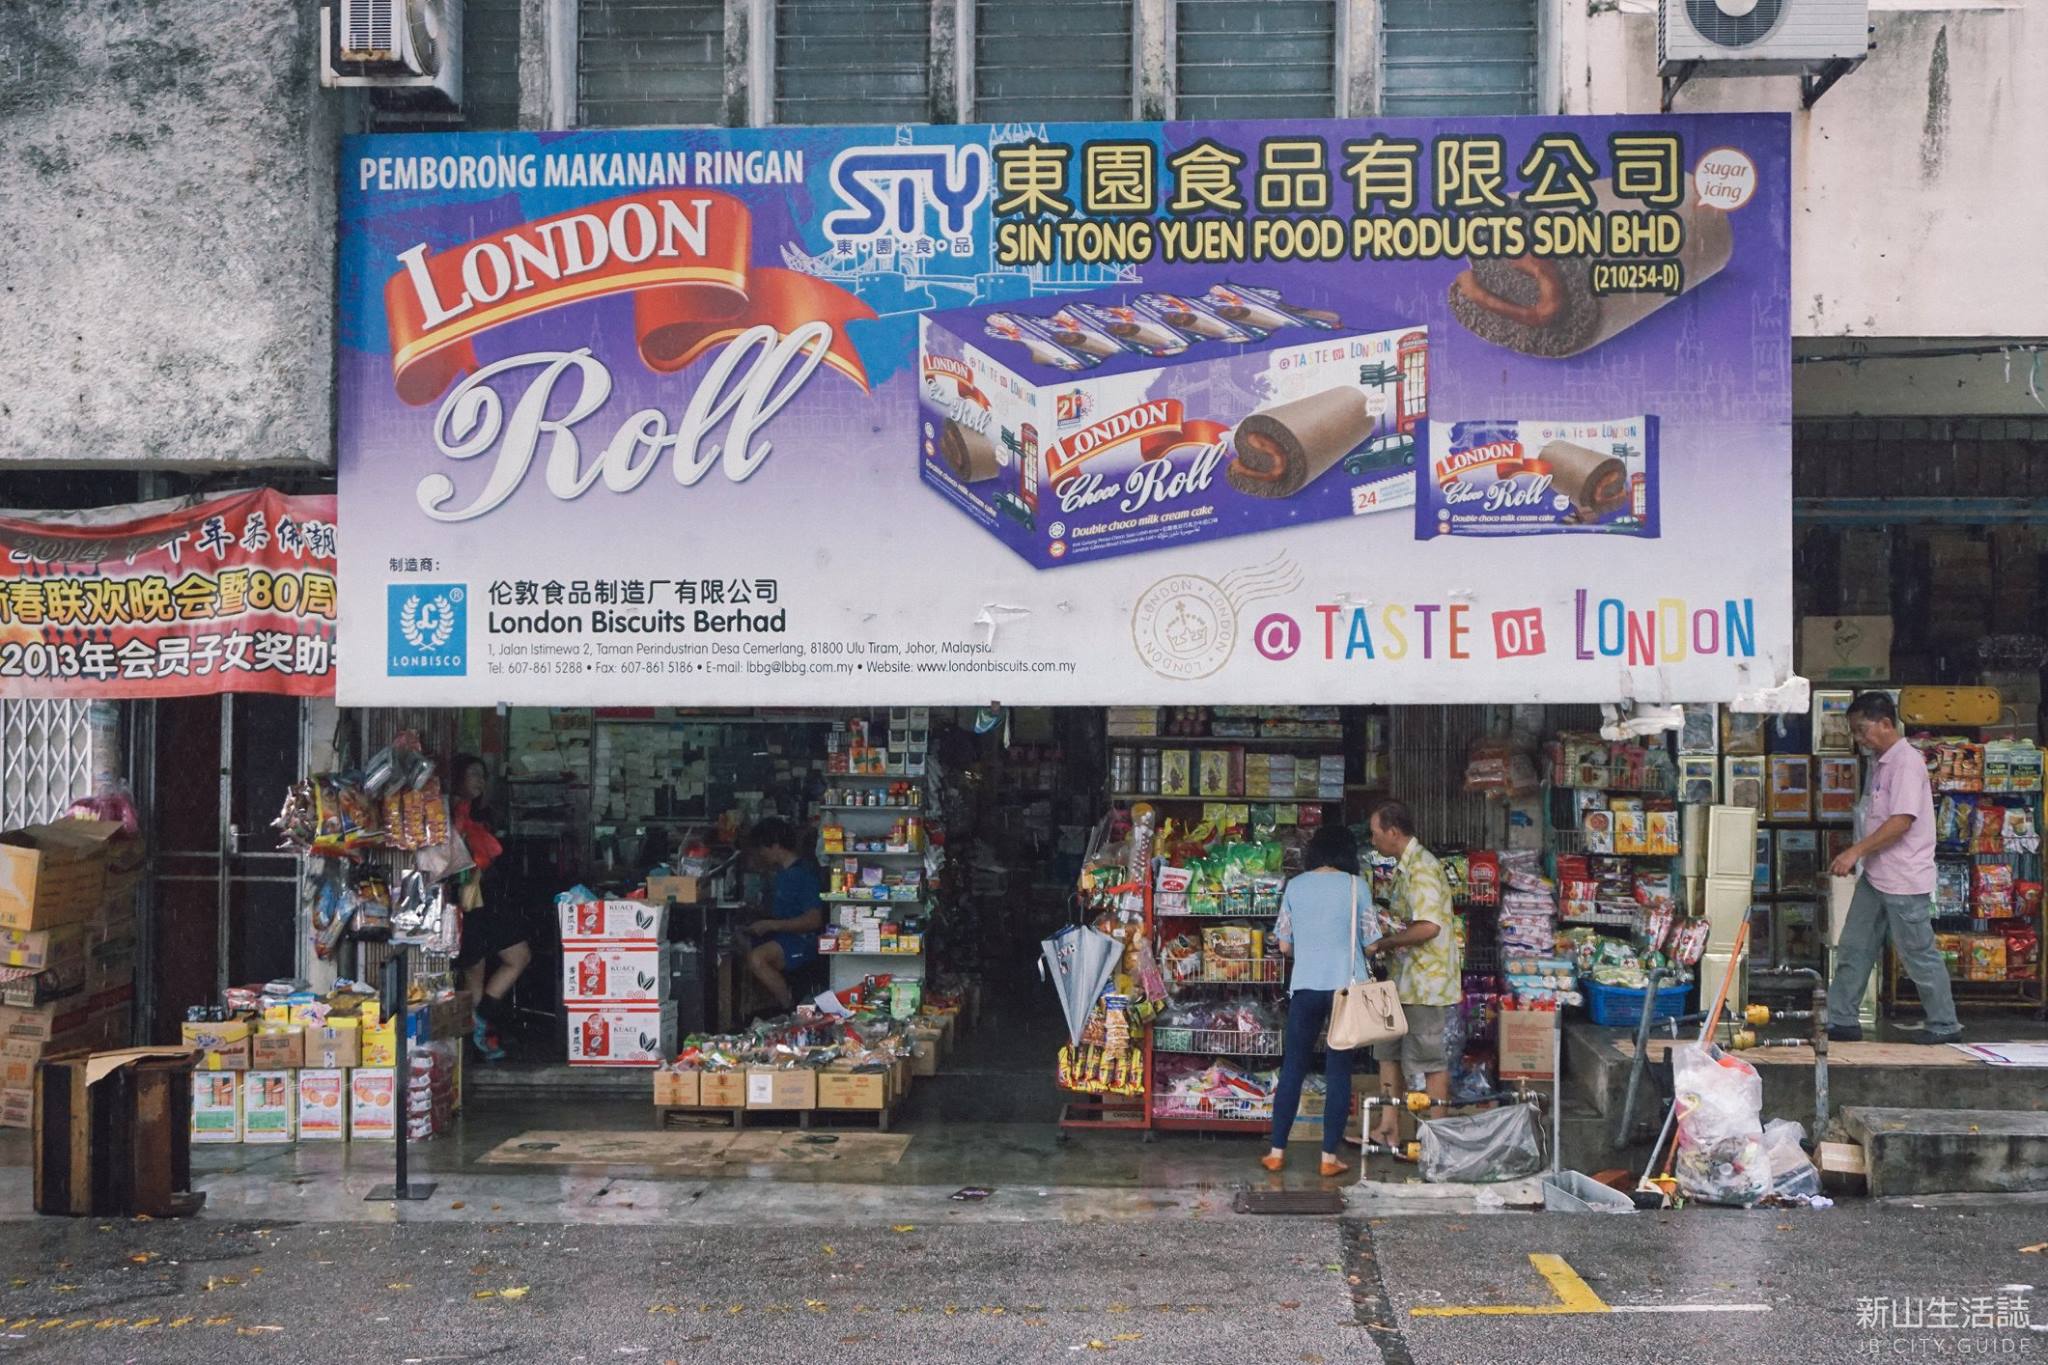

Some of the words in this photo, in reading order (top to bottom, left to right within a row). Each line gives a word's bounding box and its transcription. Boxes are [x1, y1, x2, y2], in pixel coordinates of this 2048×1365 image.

[359, 153, 537, 191] PEMBORONG
[544, 151, 689, 188] MAKANAN
[695, 150, 803, 185] RINGAN
[997, 135, 1680, 214] 東園食品有限公司
[1702, 161, 1749, 184] sugar
[1703, 181, 1742, 201] icing
[1000, 222, 1050, 261] SIN
[1060, 221, 1152, 260] TONG
[1159, 219, 1244, 260] YUEN
[1254, 219, 1343, 258] FOOD
[1353, 216, 1525, 258] PRODUCTS
[1533, 215, 1601, 256] SDN
[1611, 214, 1682, 254] BHD
[397, 199, 712, 331] LONDON
[1593, 264, 1682, 291] (210254-D)
[926, 355, 968, 379] LONDON
[416, 320, 833, 523] Roll
[1053, 402, 1168, 466] LONDON
[1442, 443, 1516, 474] LONDON
[1056, 473, 1120, 512] Choco
[1120, 440, 1227, 513] Roll
[1484, 474, 1554, 511] Roll
[1358, 491, 1377, 509] 24
[1072, 522, 1108, 539] Double
[1108, 517, 1136, 533] choco
[1138, 513, 1159, 528] milk
[1160, 509, 1190, 523] cream
[1191, 505, 1214, 518] cake
[0, 566, 337, 625] 春联欢晚会暨80周
[488, 579, 778, 605] 伦敦食品制造厂有限公司
[1141, 580, 1192, 622] LONDON
[488, 610, 583, 634] London
[592, 609, 685, 633] Biscuits
[693, 608, 786, 633] Berhad
[1315, 604, 1470, 661] TASTE
[1497, 612, 1542, 656] OF
[1575, 589, 1755, 667] LONDON
[0, 629, 337, 681] 2013年会员子女奖助
[392, 655, 462, 667] LONBISCO
[498, 643, 528, 656] Jalan
[530, 643, 580, 656] Istimewa
[595, 643, 633, 655] Taman
[636, 642, 709, 655] Perindustrian
[712, 642, 740, 655] Desa
[743, 642, 807, 657] Cemerlang,
[811, 642, 843, 654] 81800
[846, 642, 865, 654] Ulu
[868, 642, 901, 656] Tiram,
[904, 641, 938, 656] Johor,
[508, 662, 551, 674] 607-861
[555, 661, 583, 674] 5288
[621, 661, 664, 674] 607-861
[669, 661, 693, 674] 5186
[917, 660, 1077, 675] www.londonbiscuits.com.my
